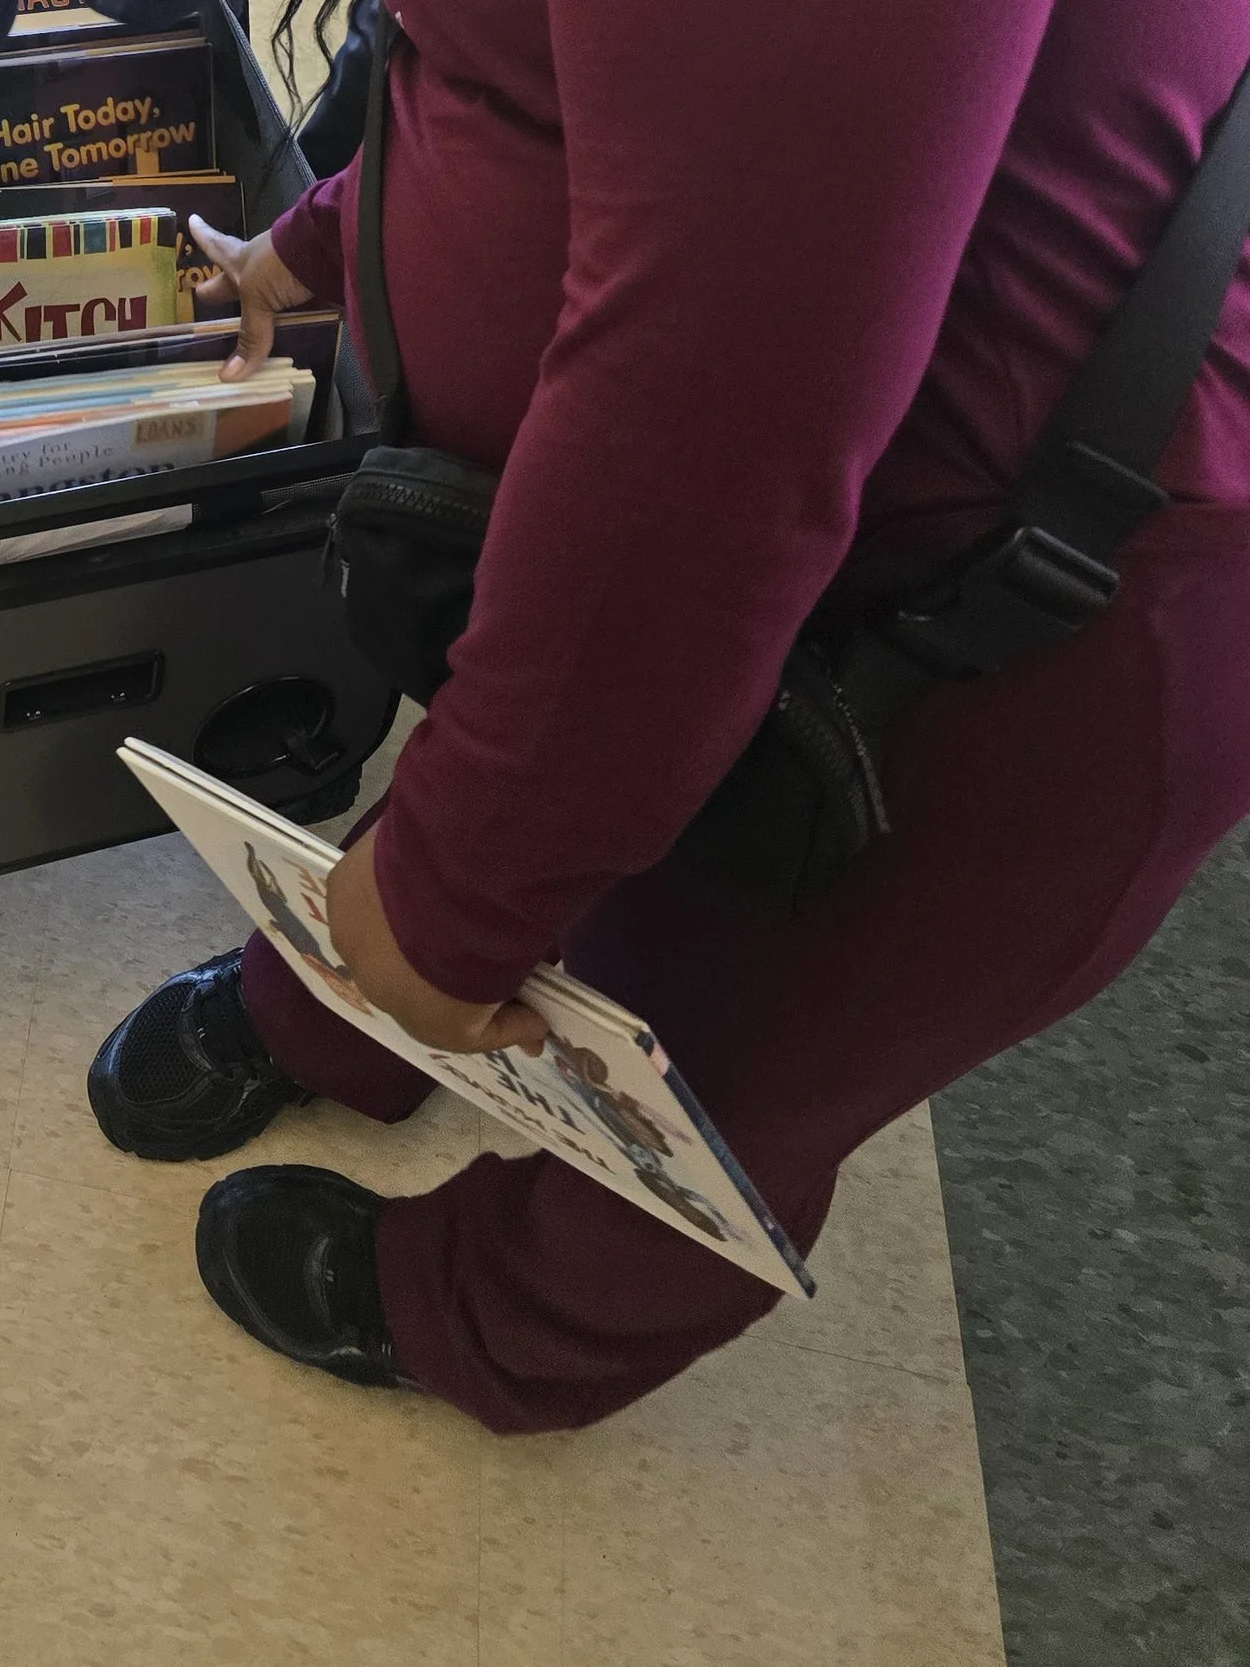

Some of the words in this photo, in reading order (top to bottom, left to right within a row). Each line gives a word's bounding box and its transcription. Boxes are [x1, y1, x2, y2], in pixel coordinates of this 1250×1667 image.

[61, 96, 160, 134] Today,
[44, 121, 196, 172] Tomorrow
[39, 446, 115, 468] People
